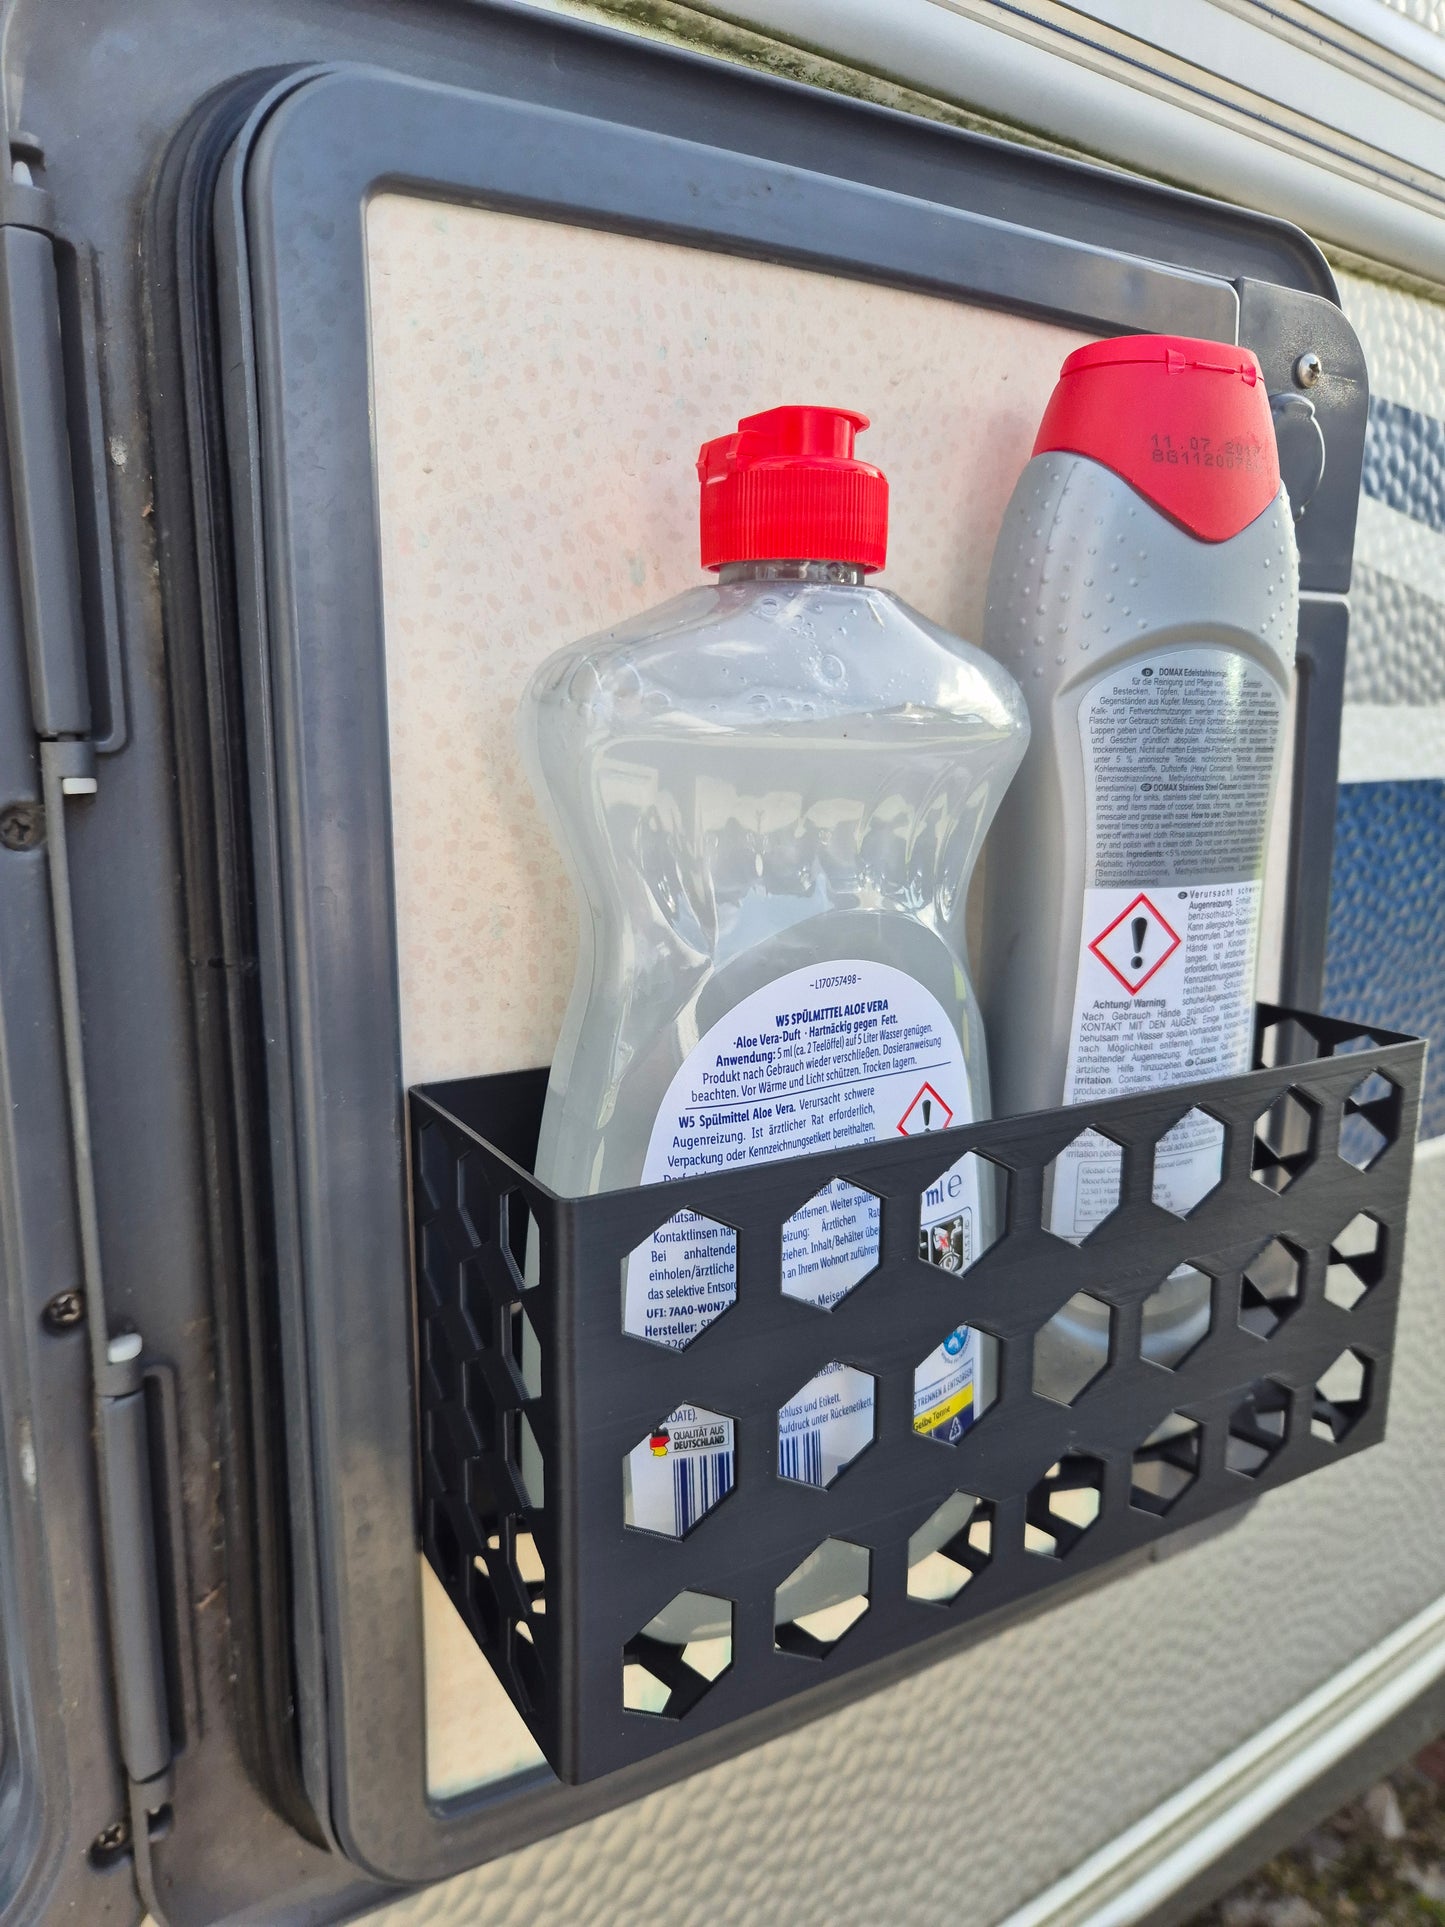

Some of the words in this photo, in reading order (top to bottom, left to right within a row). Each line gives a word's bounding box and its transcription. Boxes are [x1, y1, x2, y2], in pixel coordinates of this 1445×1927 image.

[1159, 668, 1183, 676] DOMAX
[1190, 888, 1233, 899] Verursacht
[1134, 999, 1166, 1008] Warning
[776, 1014, 789, 1027] W5
[792, 1006, 843, 1025] SPÜLMITTEL
[844, 1002, 865, 1017] ALOE
[866, 999, 889, 1013] VERA
[1082, 1012, 1104, 1021] Nach
[1111, 1011, 1150, 1021] Gebrauch
[760, 1029, 801, 1046] Vera-Duft
[809, 1020, 851, 1037] Hartnäckig
[854, 1019, 877, 1033] gegen
[881, 1014, 898, 1025] Fett.
[1081, 1022, 1122, 1031] KONTAKT
[1129, 1021, 1143, 1030] MIT
[1149, 1020, 1165, 1029] DEN
[716, 1050, 775, 1067] Anwendung:
[777, 1048, 782, 1059] 5
[783, 1046, 792, 1058] ml
[807, 1042, 812, 1053] 2
[813, 1035, 844, 1053] Teelöffel)
[846, 1034, 857, 1046] auf
[858, 1033, 862, 1045] 5
[863, 1032, 878, 1044] Liter
[880, 1029, 902, 1041] Wasser
[903, 1024, 933, 1039] genügen.
[702, 1070, 740, 1085] Produkt
[743, 1066, 764, 1080] nach
[766, 1060, 804, 1076] Gebrauch
[806, 1057, 832, 1069] wieder
[833, 1046, 881, 1063] verschließen.
[883, 1036, 942, 1055] Dosieranweisung
[691, 1088, 739, 1103] beachten.
[741, 1085, 756, 1097] Vor
[759, 1080, 787, 1094] Wärme
[789, 1075, 804, 1088] und
[806, 1072, 825, 1085] Licht
[826, 1066, 861, 1081] schützen.
[863, 1060, 890, 1074] Trocken
[893, 1056, 917, 1071] lagern.
[678, 1116, 695, 1128] W5
[699, 1109, 750, 1129] Spülmittel
[753, 1107, 772, 1120] Aloe
[776, 1103, 796, 1115] Vera.
[799, 1093, 841, 1110] Verursacht
[844, 1087, 875, 1101] schwere
[673, 1133, 746, 1150] Augenreizung.
[751, 1127, 763, 1139] Ist
[769, 1119, 806, 1135] ärztlicher
[811, 1114, 824, 1126] Rat
[829, 1103, 875, 1122] erforderlich,
[667, 1153, 723, 1169] Verpackung
[726, 1149, 746, 1161] oder
[748, 1130, 831, 1158] Kennzeichnungsetikett
[833, 1122, 875, 1139] bereithalten.
[926, 1180, 944, 1206] ml
[830, 1198, 853, 1210] Weiter
[821, 1215, 856, 1232] Ärztlichen
[653, 1228, 718, 1243] Kontaktlinsen
[811, 1231, 864, 1253] Inhalt/Behälter
[651, 1250, 667, 1263] Bei
[683, 1243, 736, 1260] anhaltende
[649, 1262, 734, 1281] einholen/ärztliche
[787, 1268, 796, 1278] an
[798, 1262, 819, 1275] Ihrem
[820, 1253, 849, 1269] Wohnort
[648, 1288, 664, 1300] das
[666, 1284, 705, 1299] selektive
[646, 1309, 667, 1319] UFI:
[645, 1323, 697, 1337] Hersteller:
[918, 1389, 942, 1406] TRENNEN
[804, 1401, 817, 1412] und
[779, 1418, 810, 1433] Aufdruck
[811, 1413, 829, 1426] unter
[674, 1427, 707, 1440] QUALITÄT
[710, 1425, 724, 1435] AUS
[674, 1435, 725, 1450] DEUTSCHLAND
